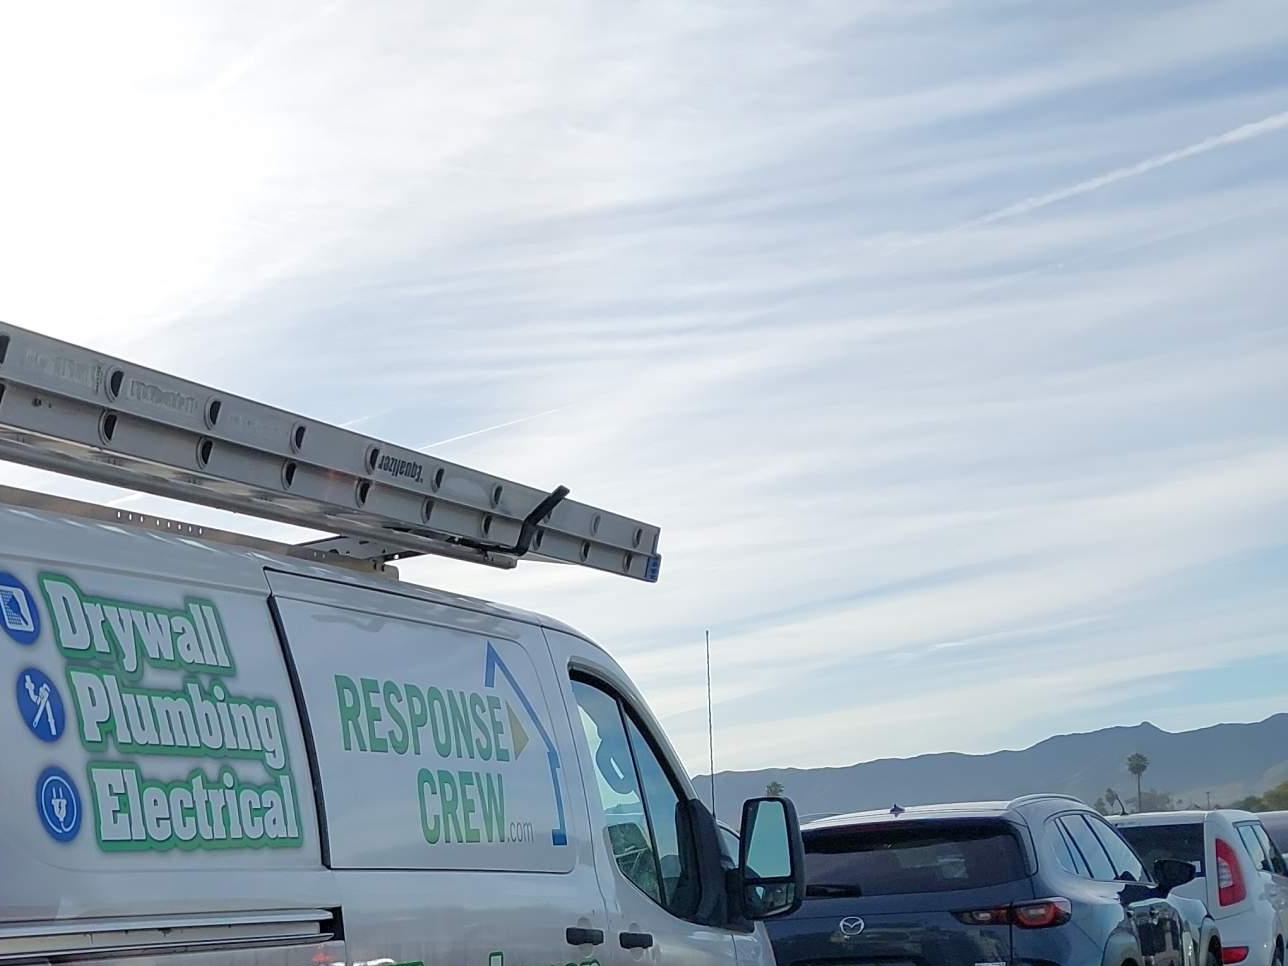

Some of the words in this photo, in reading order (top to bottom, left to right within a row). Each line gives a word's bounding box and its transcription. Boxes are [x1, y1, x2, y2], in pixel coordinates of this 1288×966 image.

[47, 579, 231, 672] Drywall
[81, 672, 284, 769] Plumbing
[335, 673, 511, 762] RESPONSE
[96, 769, 300, 843] Electrical
